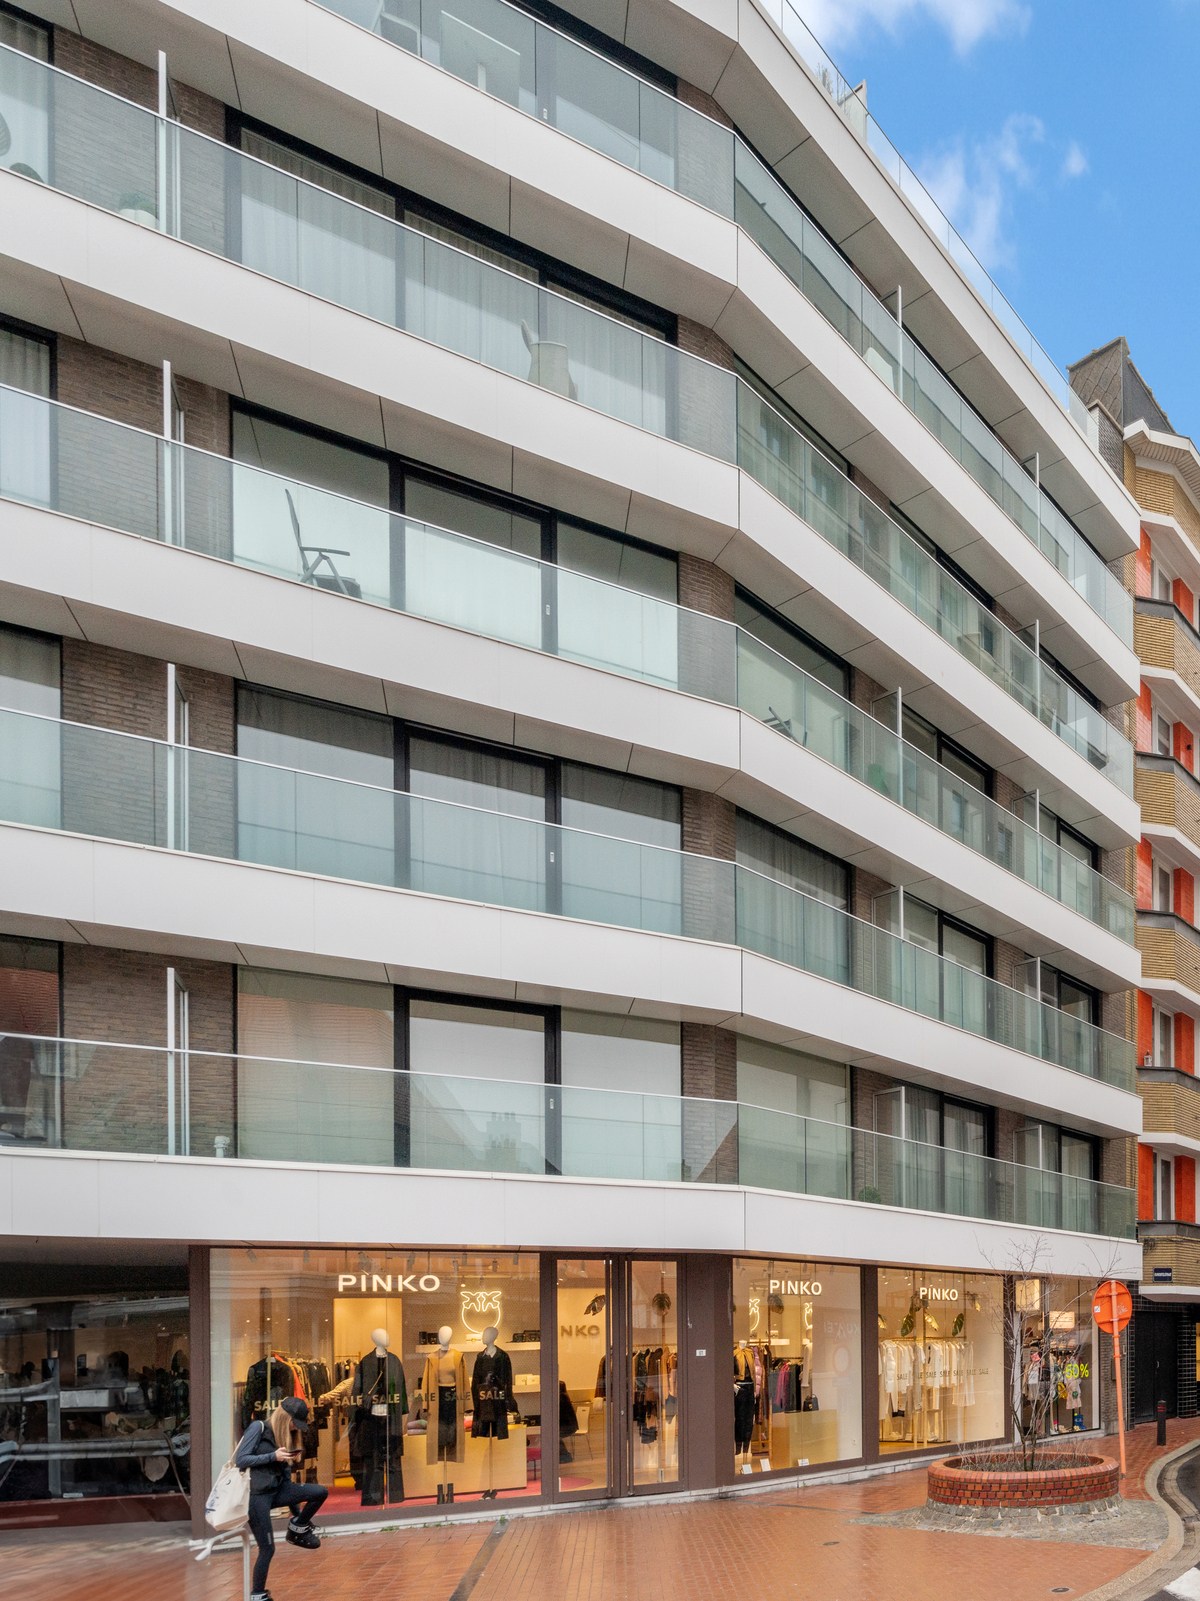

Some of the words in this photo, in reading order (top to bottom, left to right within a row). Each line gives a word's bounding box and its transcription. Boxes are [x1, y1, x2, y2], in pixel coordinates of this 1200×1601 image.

[338, 1274, 441, 1292] PINKO
[769, 1279, 822, 1296] PINKO
[919, 1287, 959, 1301] PINKO
[897, 1373, 908, 1381] SALE
[978, 1367, 989, 1375] SALE
[334, 1395, 363, 1407] SALE
[372, 1393, 400, 1404] SALE
[445, 1392, 471, 1401] SALE
[480, 1390, 505, 1400] SALE
